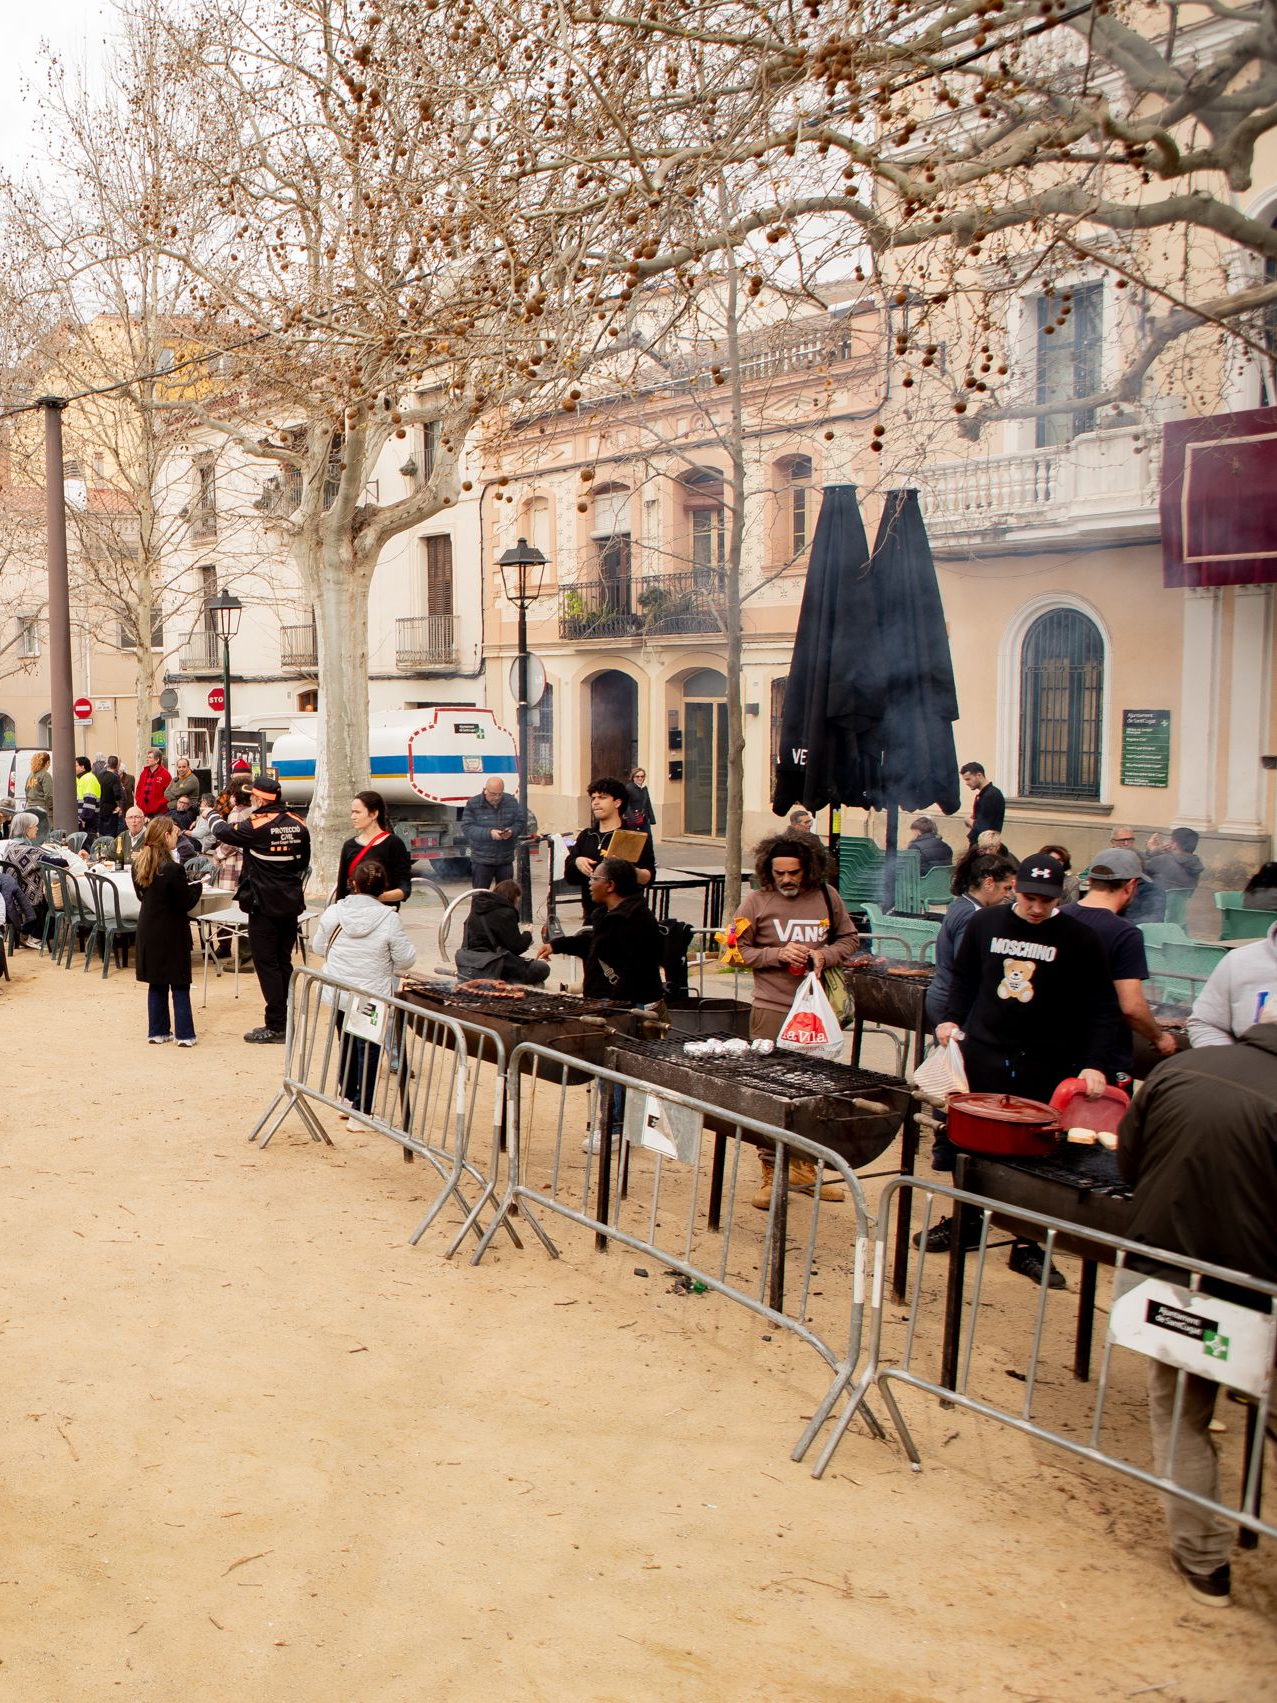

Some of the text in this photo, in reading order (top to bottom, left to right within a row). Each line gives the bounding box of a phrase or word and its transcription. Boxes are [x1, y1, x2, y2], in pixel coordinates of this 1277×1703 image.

[209, 696, 224, 704] STO
[270, 825, 301, 835] PROTECCIÓ
[280, 833, 294, 841] CIVIL
[773, 919, 829, 942] VANS
[990, 937, 1057, 962] MOSCHINO
[1158, 1306, 1202, 1326] Ajuntament
